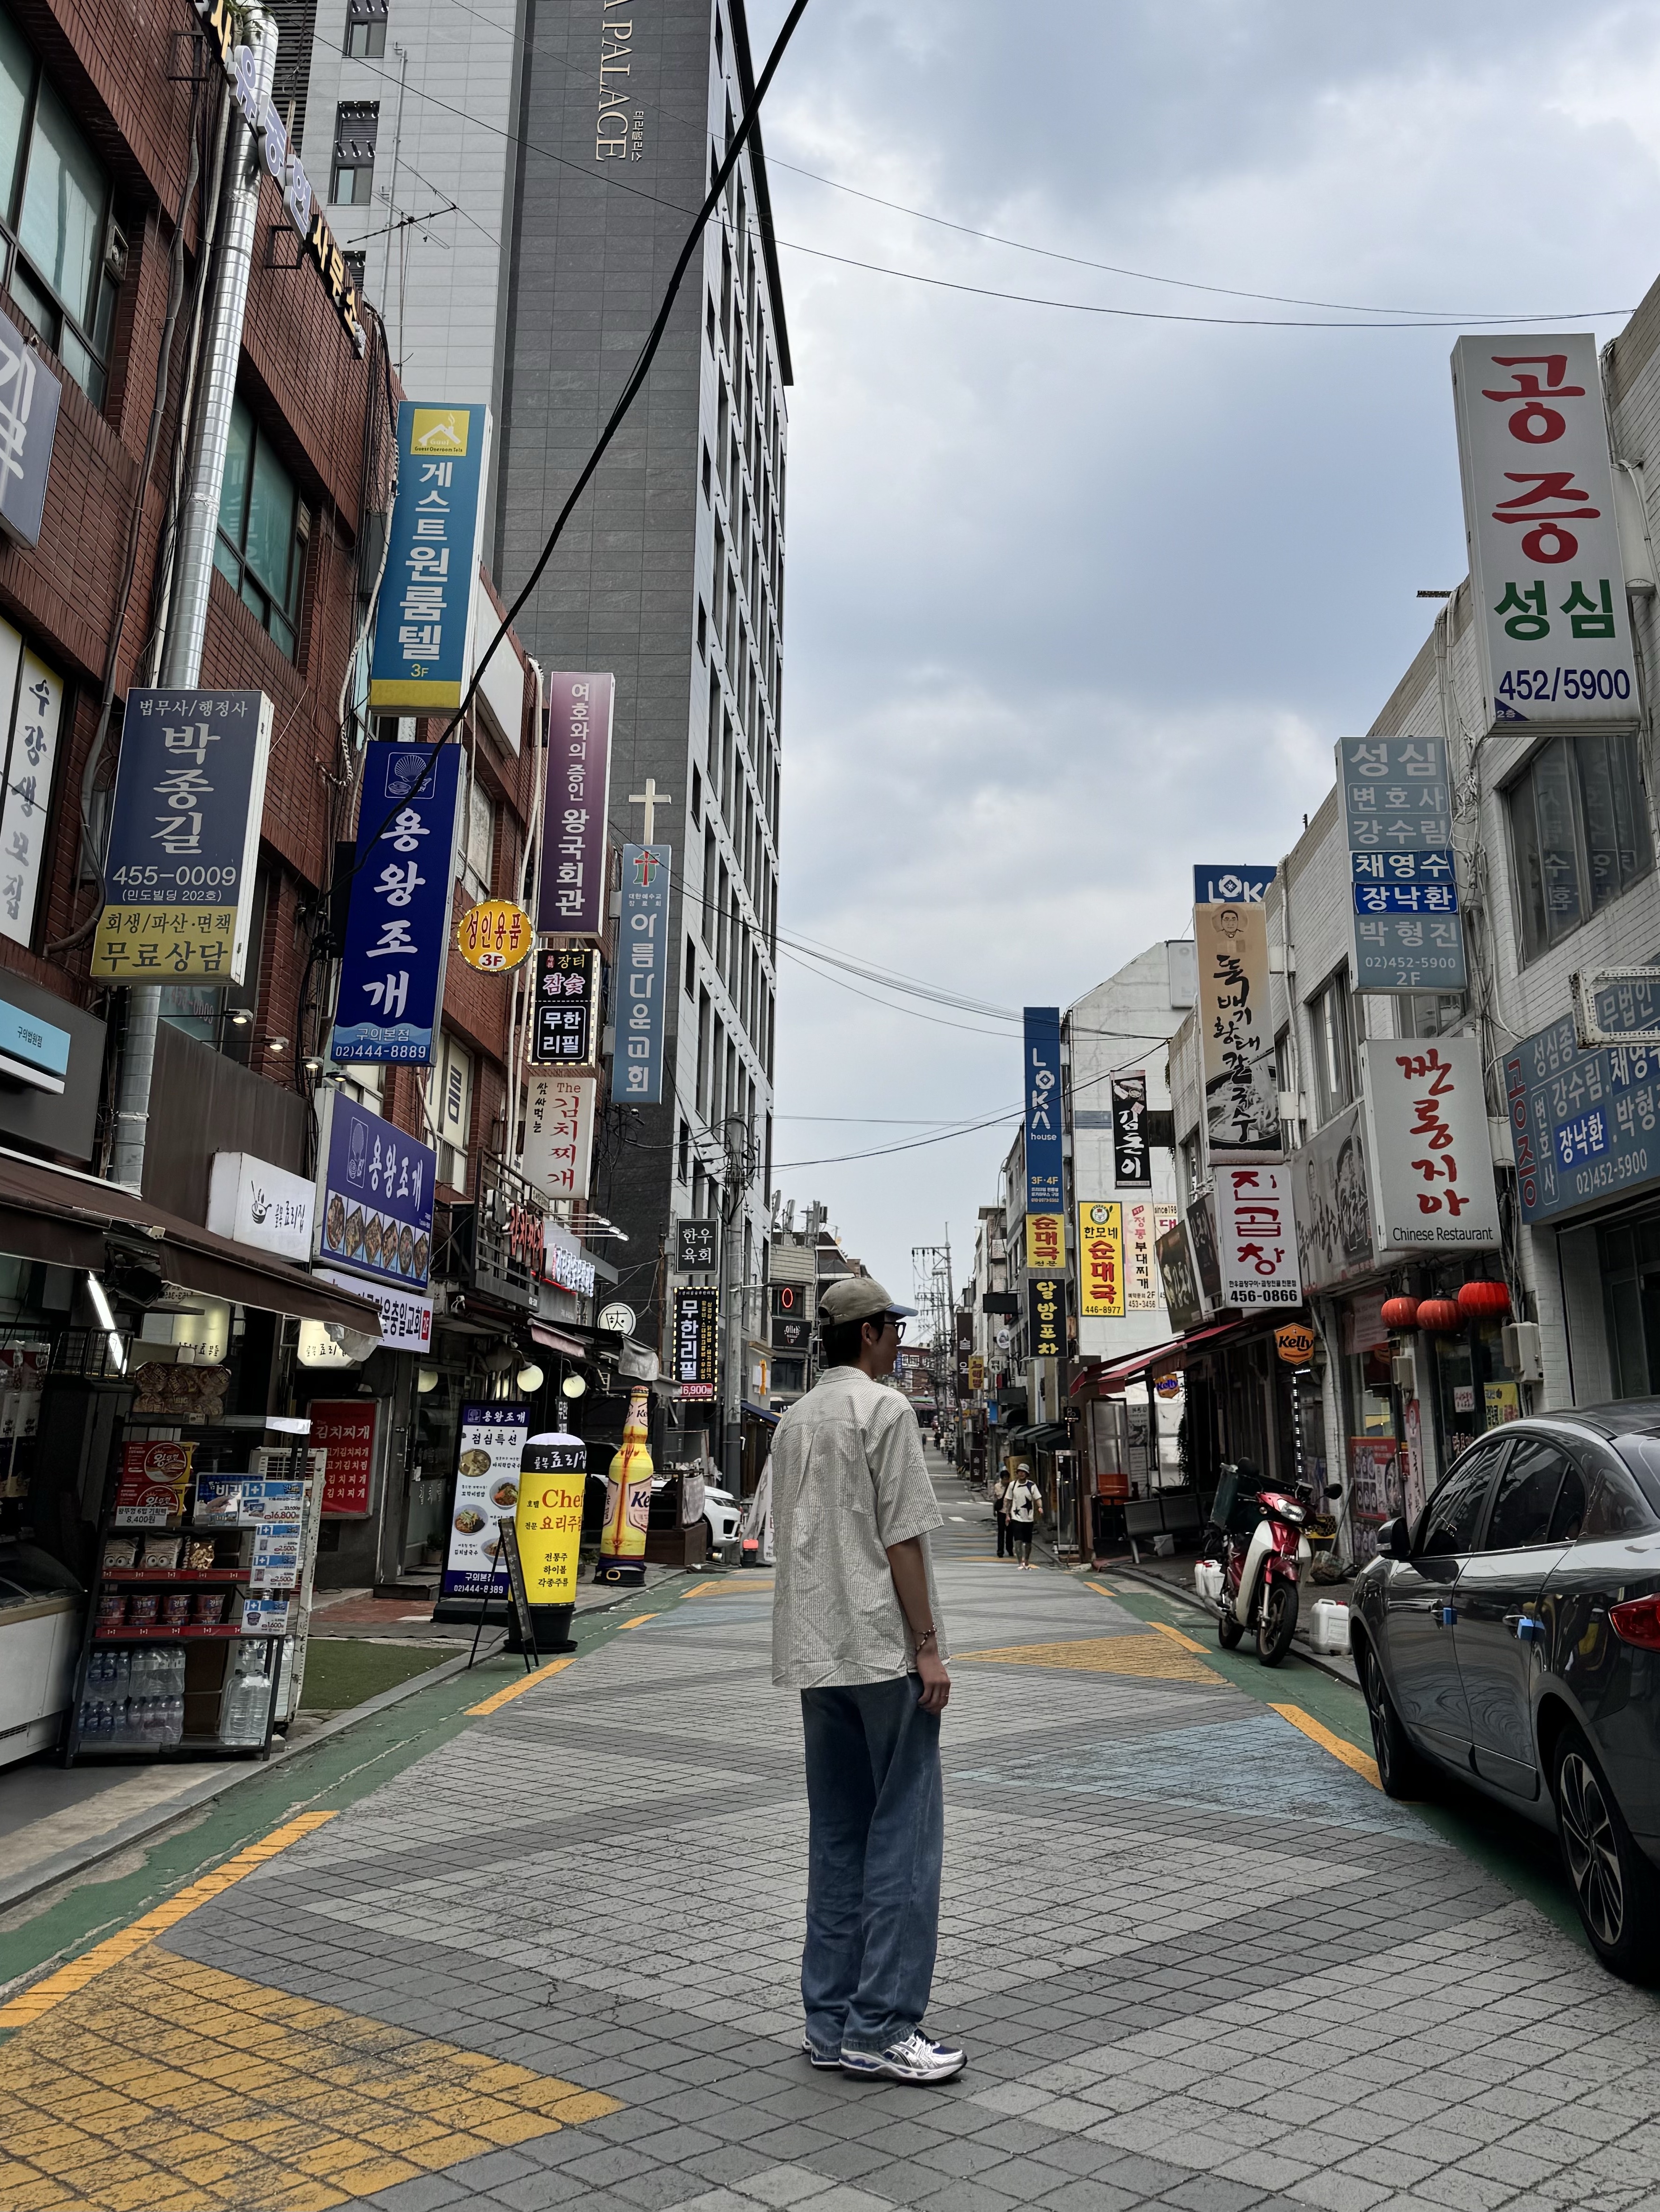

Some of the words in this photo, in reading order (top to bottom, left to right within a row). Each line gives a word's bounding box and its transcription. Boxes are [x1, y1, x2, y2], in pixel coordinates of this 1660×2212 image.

[596, 19, 633, 161] PALACE
[1481, 354, 1601, 564] 공증
[398, 462, 453, 661] 게스트원룸텔
[1494, 579, 1616, 641] 성심
[411, 663, 429, 677] 3F
[1499, 666, 1630, 702] 452/5900
[140, 699, 248, 718] 법무사/행정사
[1350, 742, 1437, 777] 성심
[151, 722, 221, 854] 박종길
[1353, 786, 1444, 813] 변호사
[1353, 819, 1447, 845] 강수림
[556, 808, 590, 917] 왕국회관
[1355, 853, 1450, 879] 채영수
[112, 865, 237, 887] 455-0009
[182, 890, 222, 903] 202호)
[1363, 886, 1452, 911] 장낙환
[362, 807, 430, 1018] 용왕조개
[466, 910, 522, 951] 성인용품
[1359, 920, 1459, 948] 박형진
[100, 940, 229, 973] 무료상담
[482, 954, 503, 967] 3F
[558, 954, 585, 969] 장터
[1365, 957, 1456, 969] 02)452-5900
[1396, 972, 1421, 986] 2F
[626, 913, 657, 1092] 아름다운교회
[543, 1011, 581, 1030] 무한
[17, 1025, 43, 1048] 구의법원점
[355, 1027, 410, 1042] 구의본점
[335, 1044, 427, 1059] 02)444-8889
[543, 1035, 579, 1054] 리필
[557, 1082, 581, 1093] The
[1616, 1089, 1660, 1137] 박형
[1507, 1057, 1537, 1207] 공증
[1559, 1111, 1603, 1164] 장낙환
[547, 1095, 579, 1192] 김치찌개
[1535, 1098, 1555, 1196] 변호사
[368, 1134, 423, 1212] 용왕조개
[1576, 1148, 1648, 1195] 02)452-5900
[1230, 1170, 1285, 1275] 진곱창
[682, 1228, 713, 1245] 한우
[1031, 1216, 1060, 1260] 순대국
[1084, 1226, 1118, 1240] 한모네
[1393, 1226, 1434, 1241] Chinese
[1437, 1226, 1493, 1241] Restaurant
[681, 1247, 712, 1264] 육회
[1088, 1240, 1117, 1304] 순대국
[1135, 1242, 1149, 1289] 부대찌개
[1230, 1289, 1297, 1302] 456-0866
[1036, 1281, 1059, 1354] 달밤포차
[1085, 1305, 1121, 1314] 446-8977
[680, 1300, 699, 1380] 무한리필
[1278, 1335, 1314, 1352] Kelly
[1156, 1377, 1179, 1390] Kelly
[482, 1410, 526, 1424] 용왕조개
[316, 1425, 370, 1440] 김치찌개
[472, 1432, 517, 1446] 점심특선
[533, 1456, 549, 1470] 골목
[328, 1474, 366, 1484] 김치찌개
[244, 1483, 266, 1497] 1+1
[327, 1488, 365, 1498] 김치찌개
[527, 1500, 539, 1509] 호텔
[126, 1515, 156, 1524] 8,400원
[525, 1522, 537, 1531] 전문
[257, 1525, 274, 1535] 1+1
[253, 1555, 269, 1566] 1+1
[544, 1552, 568, 1562] 전통주
[543, 1565, 567, 1575] 하이볼
[538, 1577, 569, 1588] 각종주류
[246, 1600, 261, 1610] 1+1
